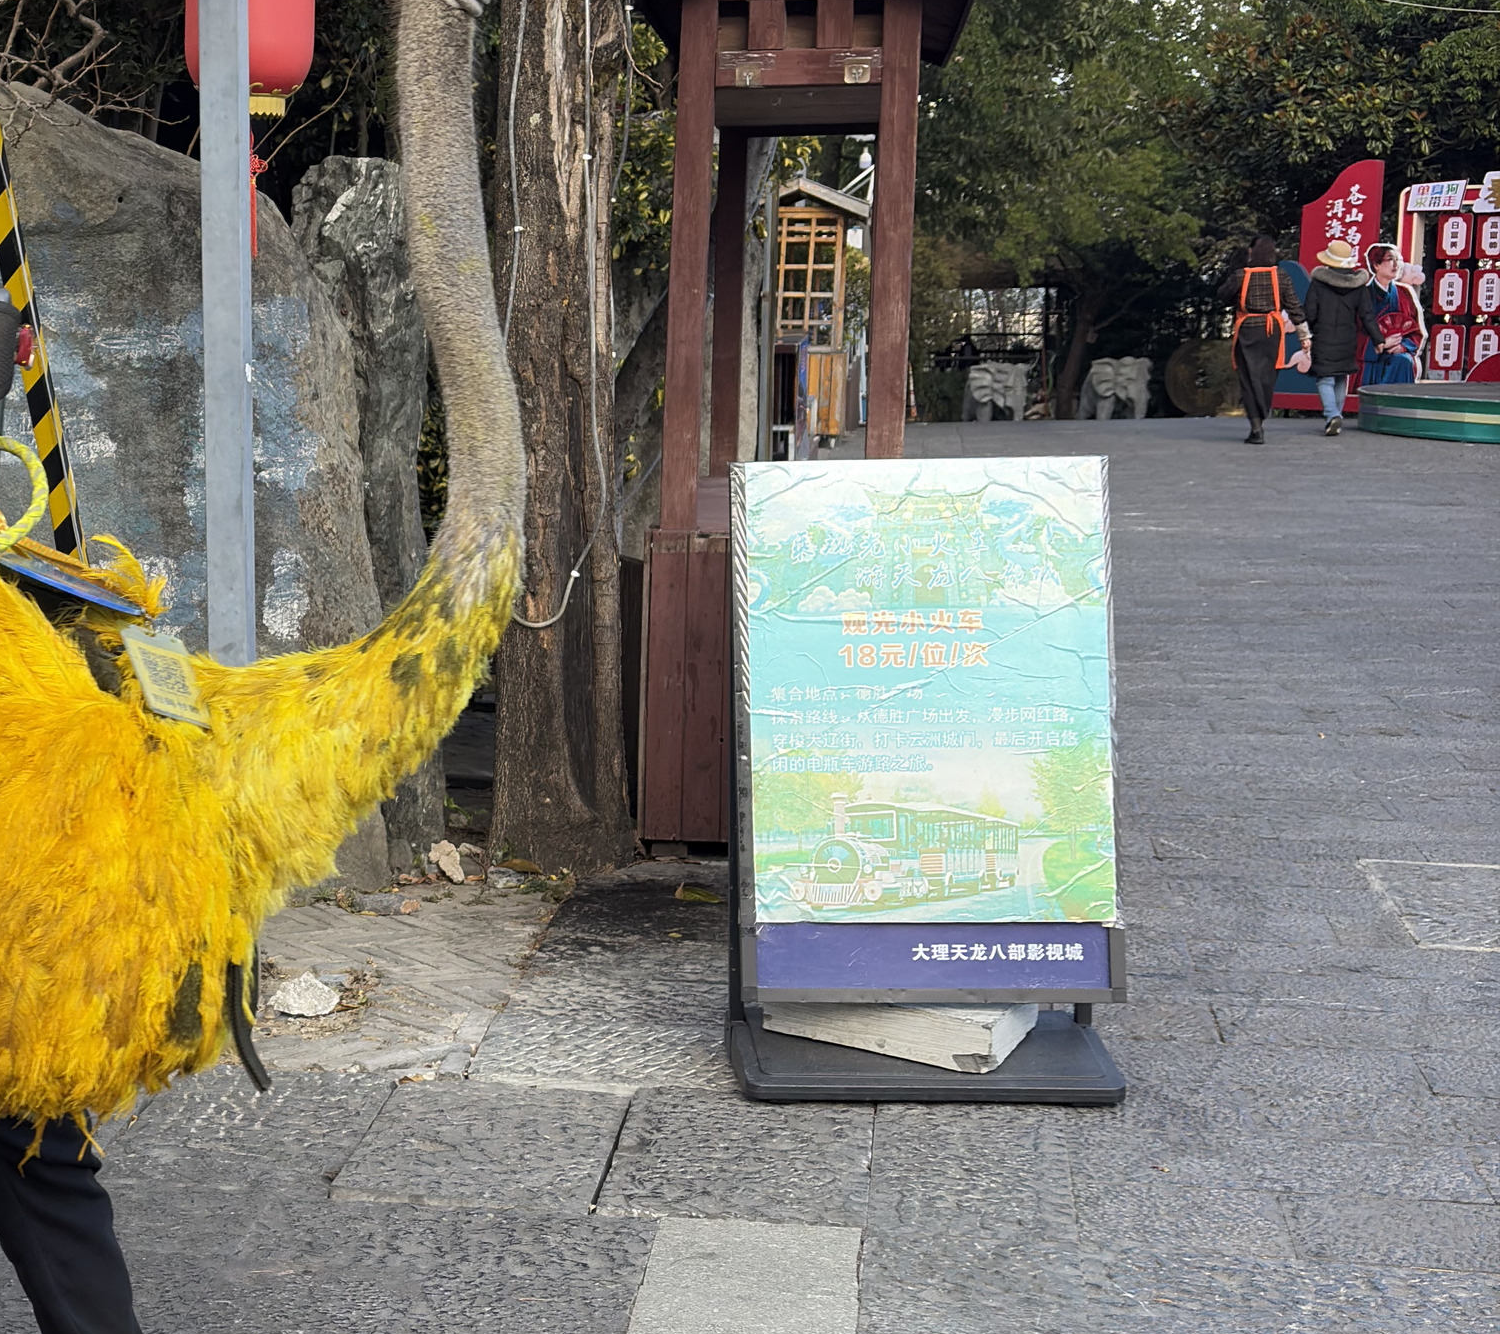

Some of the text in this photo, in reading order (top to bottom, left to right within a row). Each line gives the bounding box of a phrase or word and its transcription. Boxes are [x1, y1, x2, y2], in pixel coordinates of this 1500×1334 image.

[840, 610, 984, 635] 观光小火车
[838, 642, 990, 668] 18元/位/次
[911, 943, 1085, 962] 大理天龙八部影视城
